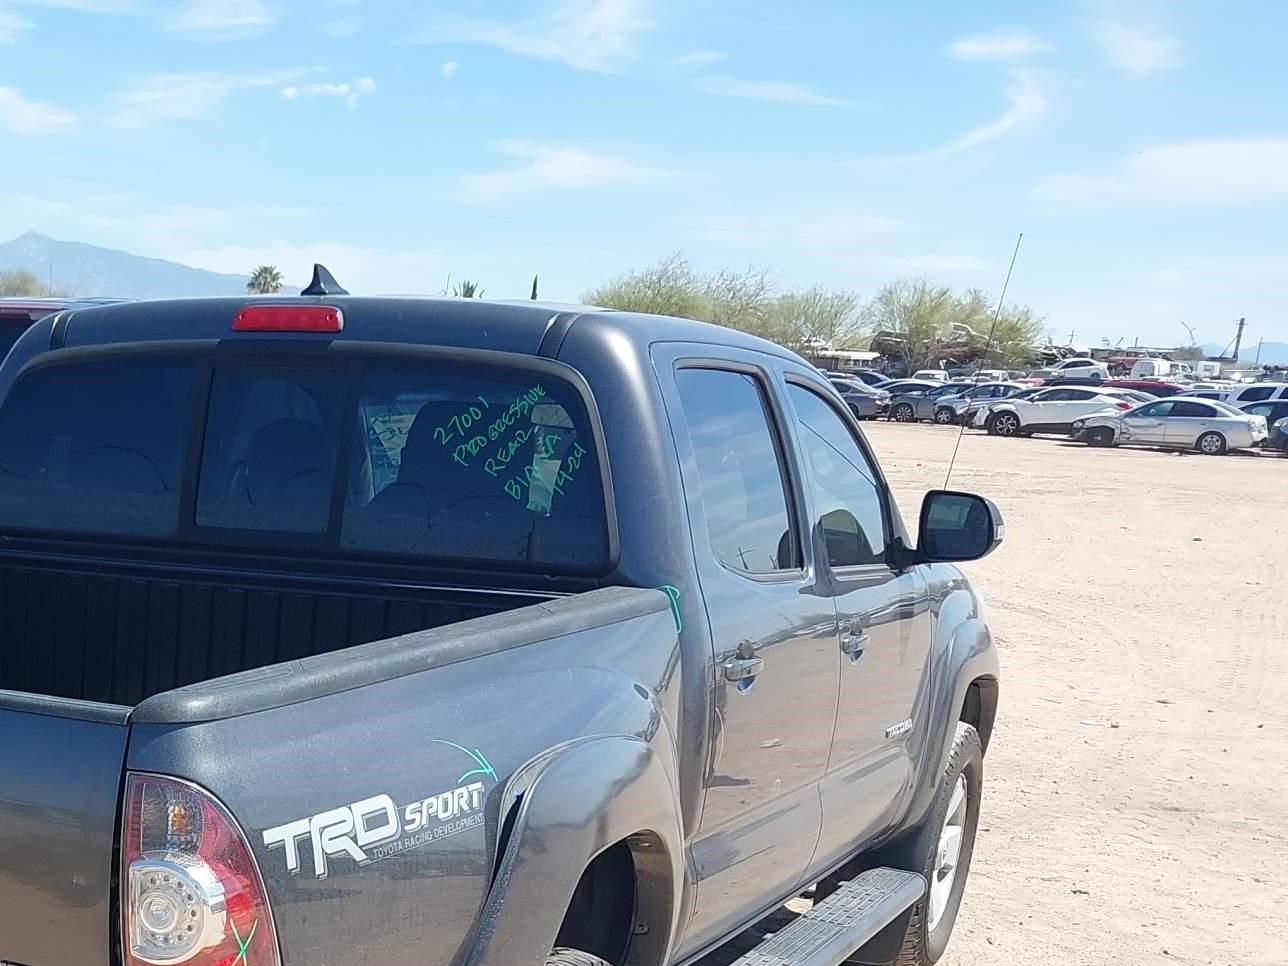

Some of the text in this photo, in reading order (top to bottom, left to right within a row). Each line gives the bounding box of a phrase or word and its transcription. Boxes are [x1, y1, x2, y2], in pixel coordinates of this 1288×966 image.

[263, 781, 485, 880] TRD SPORT
[372, 812, 485, 860] TOYOTA RACING DEVELOPMENT
